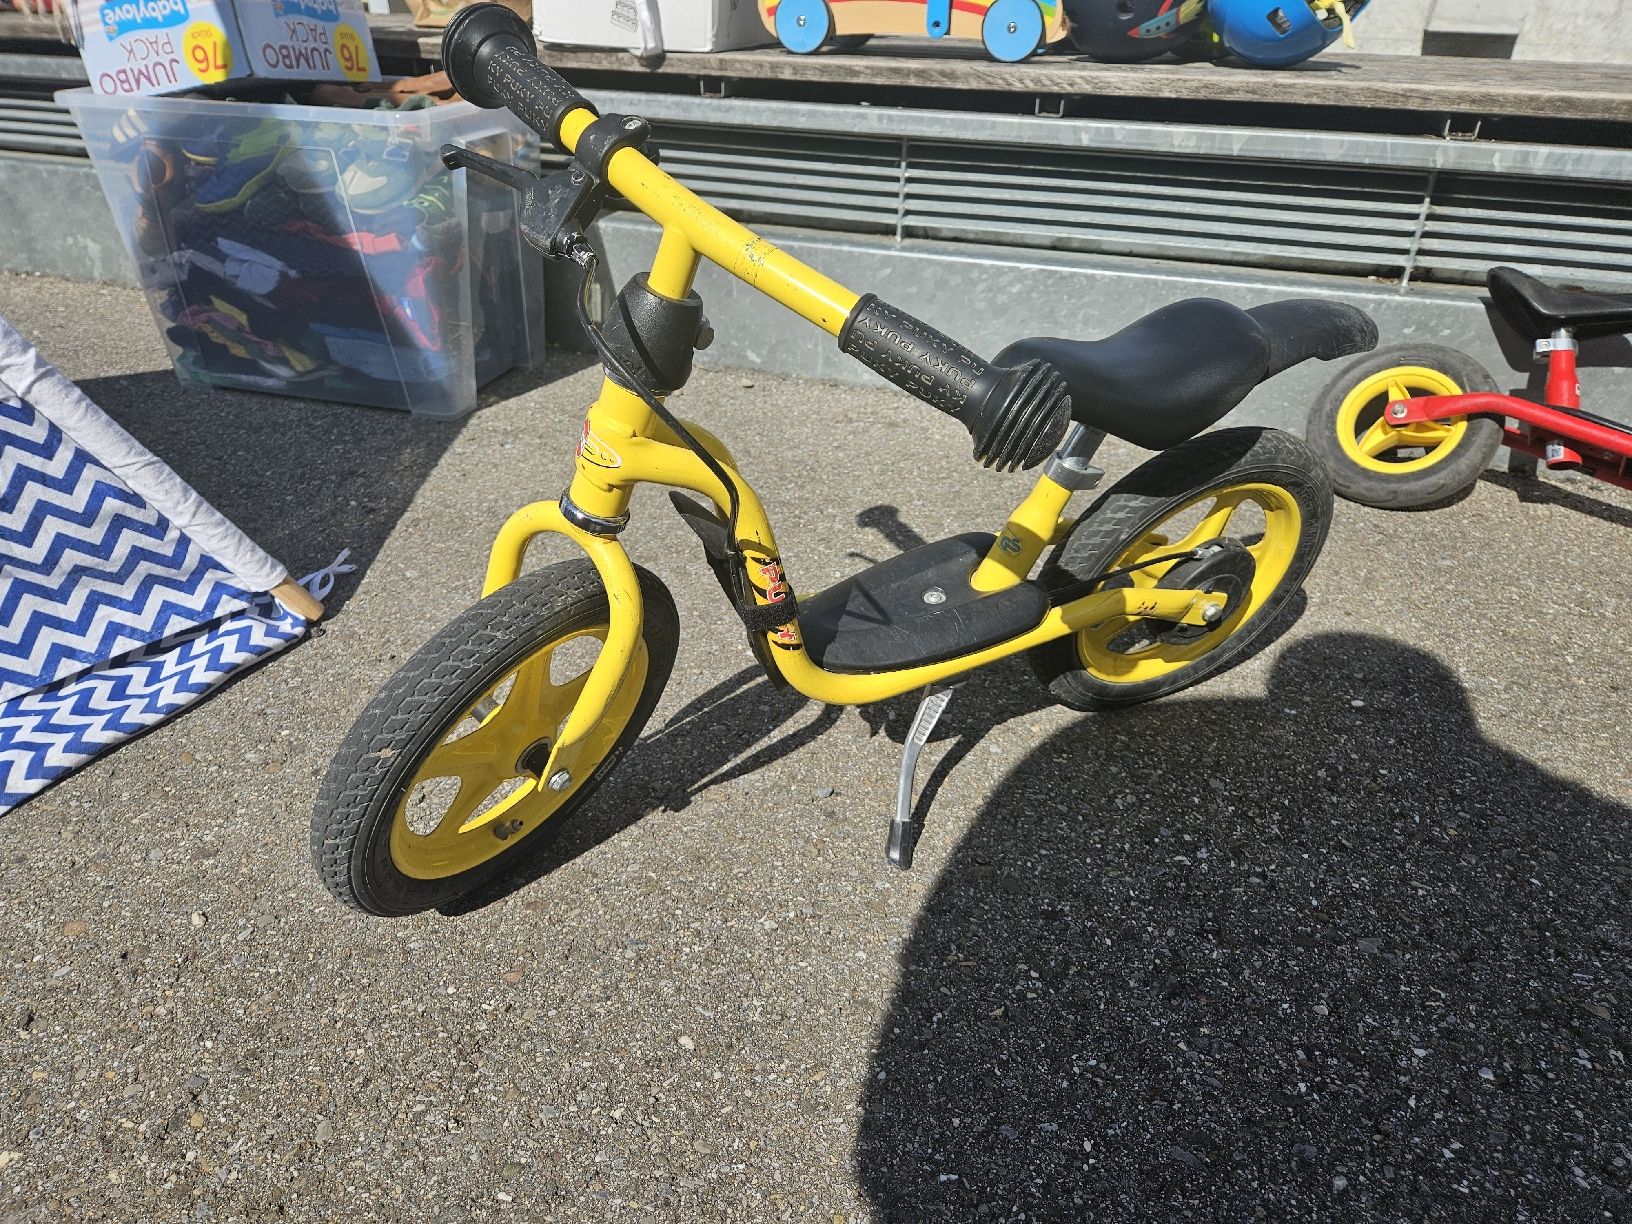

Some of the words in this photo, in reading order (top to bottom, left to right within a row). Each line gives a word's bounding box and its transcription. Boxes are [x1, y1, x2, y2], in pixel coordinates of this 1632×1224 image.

[104, 0, 185, 23] babylove
[120, 32, 174, 62] PACK
[284, 21, 328, 44] PACK
[192, 40, 228, 73] 76
[262, 42, 333, 71] JUMBO
[340, 43, 367, 72] 76
[99, 58, 179, 95] JUMBO
[503, 74, 535, 102] PUKY
[858, 315, 916, 352] PUKY
[880, 348, 935, 386] PUKY
[917, 351, 977, 390] PUKY
